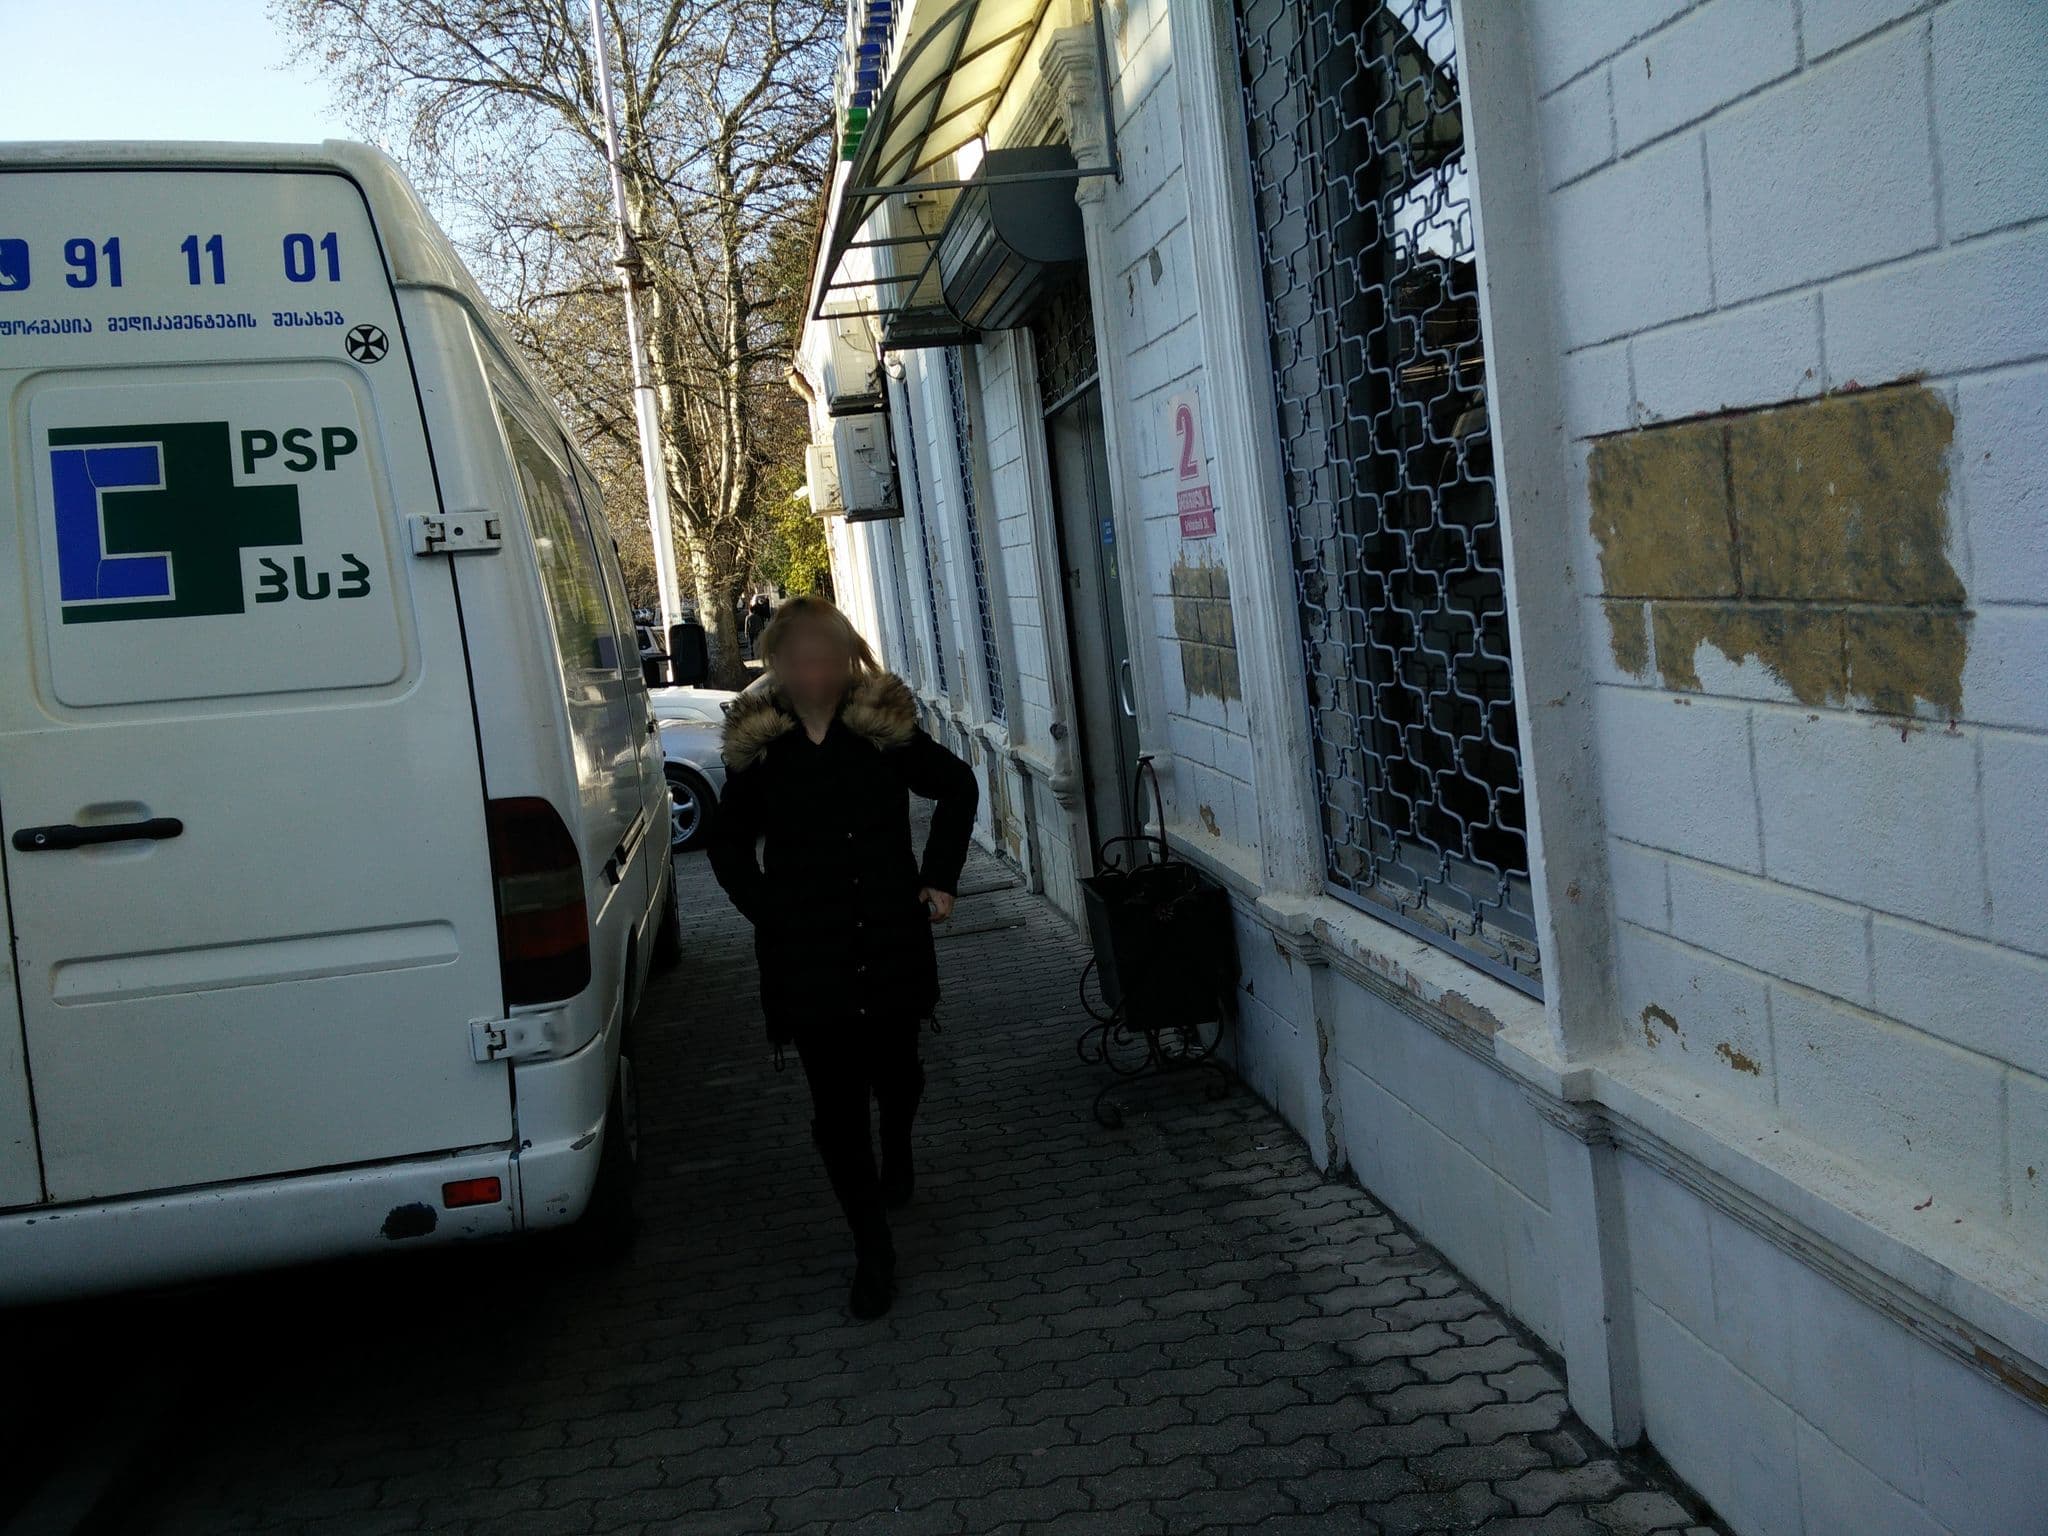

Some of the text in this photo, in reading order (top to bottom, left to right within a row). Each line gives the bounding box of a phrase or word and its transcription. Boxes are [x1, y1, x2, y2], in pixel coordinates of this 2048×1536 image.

[64, 232, 340, 288] 91 11 01
[107, 313, 256, 332] მედიკამენტების
[272, 310, 345, 327] შესახებ
[241, 427, 358, 474] PSP
[1176, 403, 1199, 481] 2
[255, 553, 371, 603] პსპ
